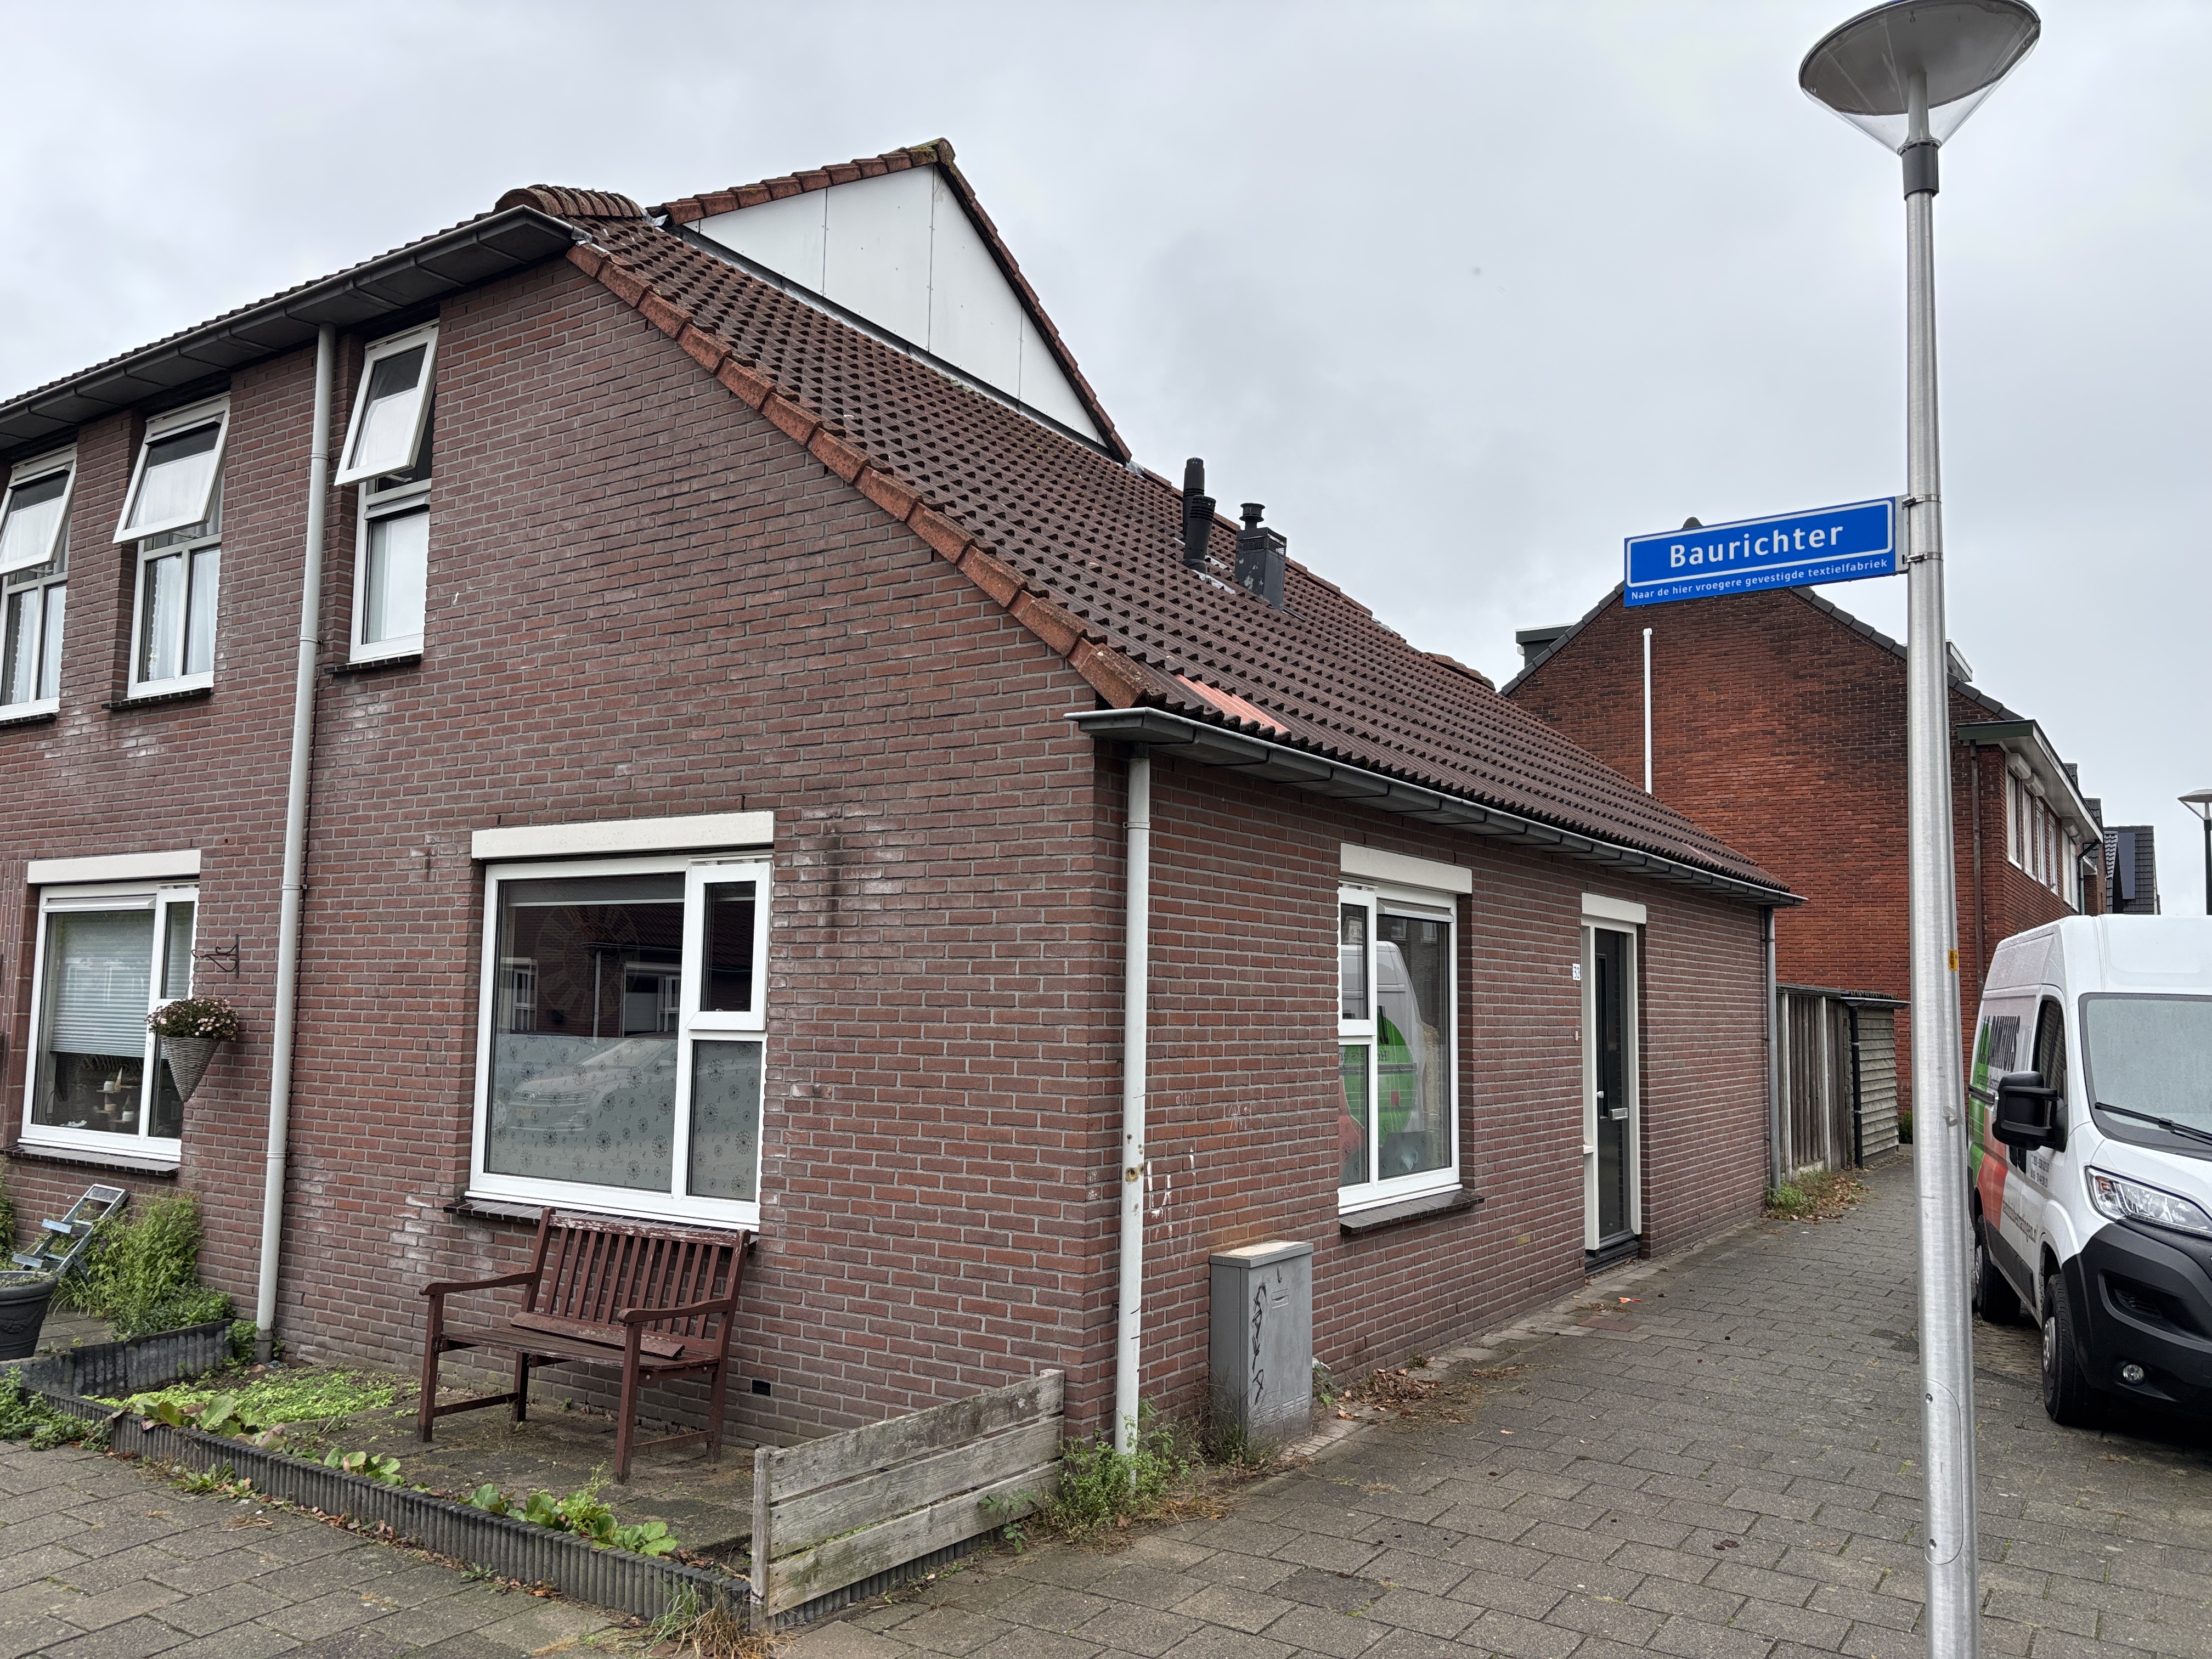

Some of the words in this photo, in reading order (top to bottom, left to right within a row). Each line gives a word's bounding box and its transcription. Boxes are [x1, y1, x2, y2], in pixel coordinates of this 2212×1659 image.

[1671, 526, 1843, 568] Baurichter
[1632, 590, 1655, 600] Naar
[1657, 588, 1669, 596] de
[1673, 585, 1693, 595] hier
[1696, 579, 1742, 591] vroegere
[1745, 570, 1804, 587] gevestigde
[1808, 558, 1888, 577] textielfabriek
[1986, 1015, 2021, 1073] DAMHUIS
